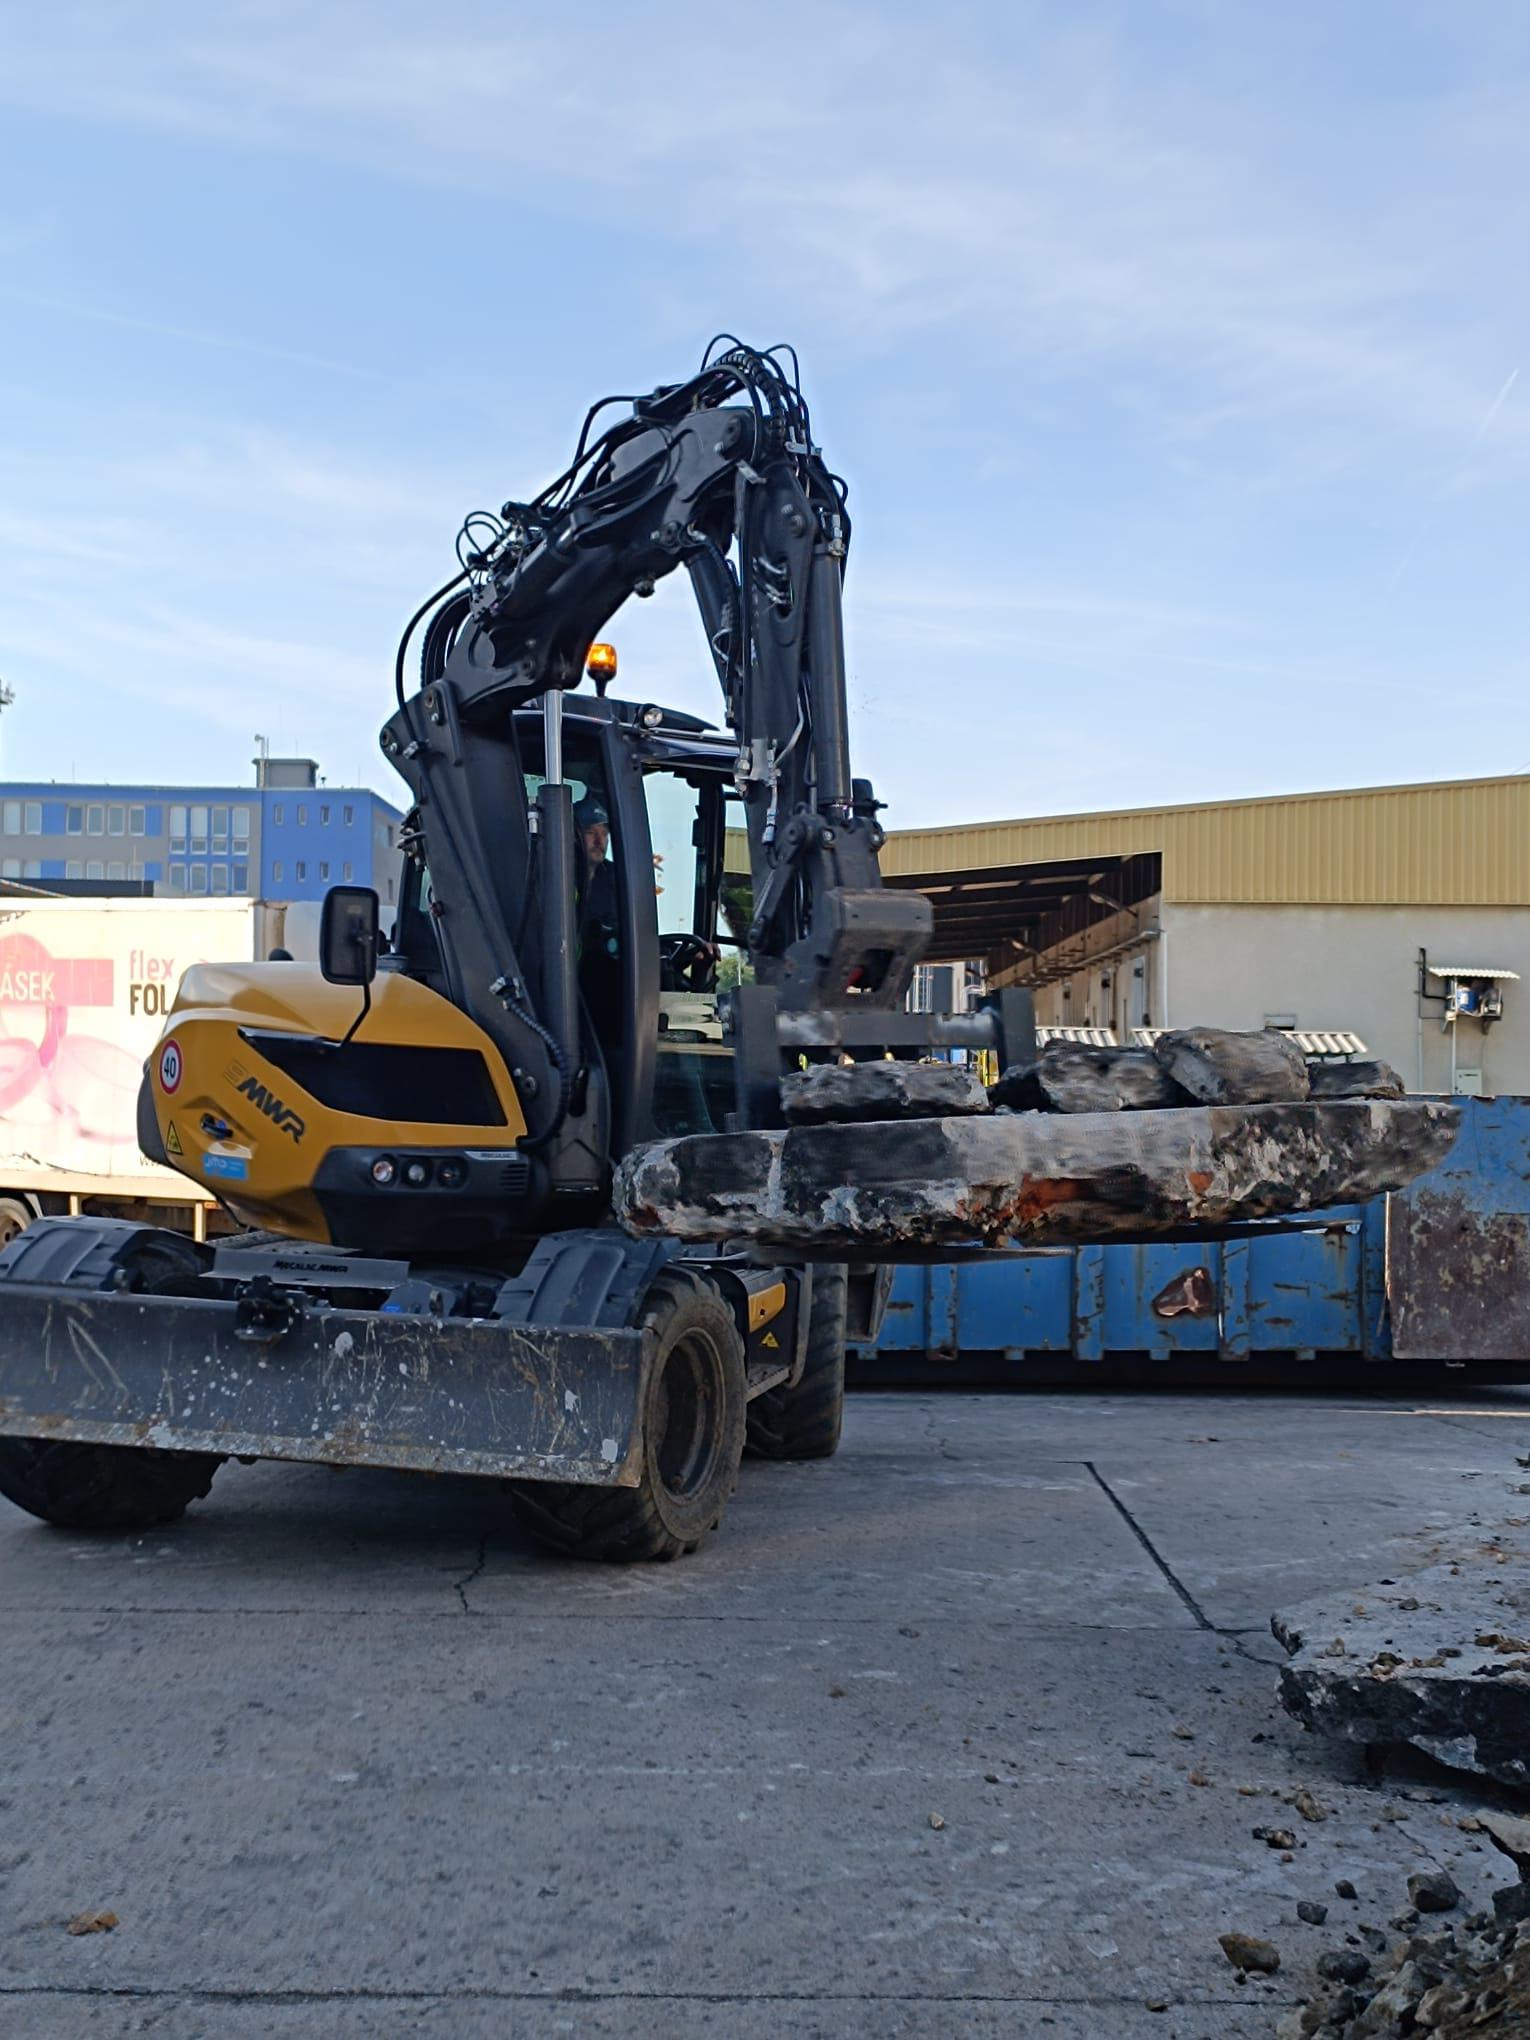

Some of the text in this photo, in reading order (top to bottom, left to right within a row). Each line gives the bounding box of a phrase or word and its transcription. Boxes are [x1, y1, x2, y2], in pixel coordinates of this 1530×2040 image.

[0, 961, 56, 1001] ÁSEK
[130, 949, 175, 981] flex
[164, 1056, 176, 1078] 40
